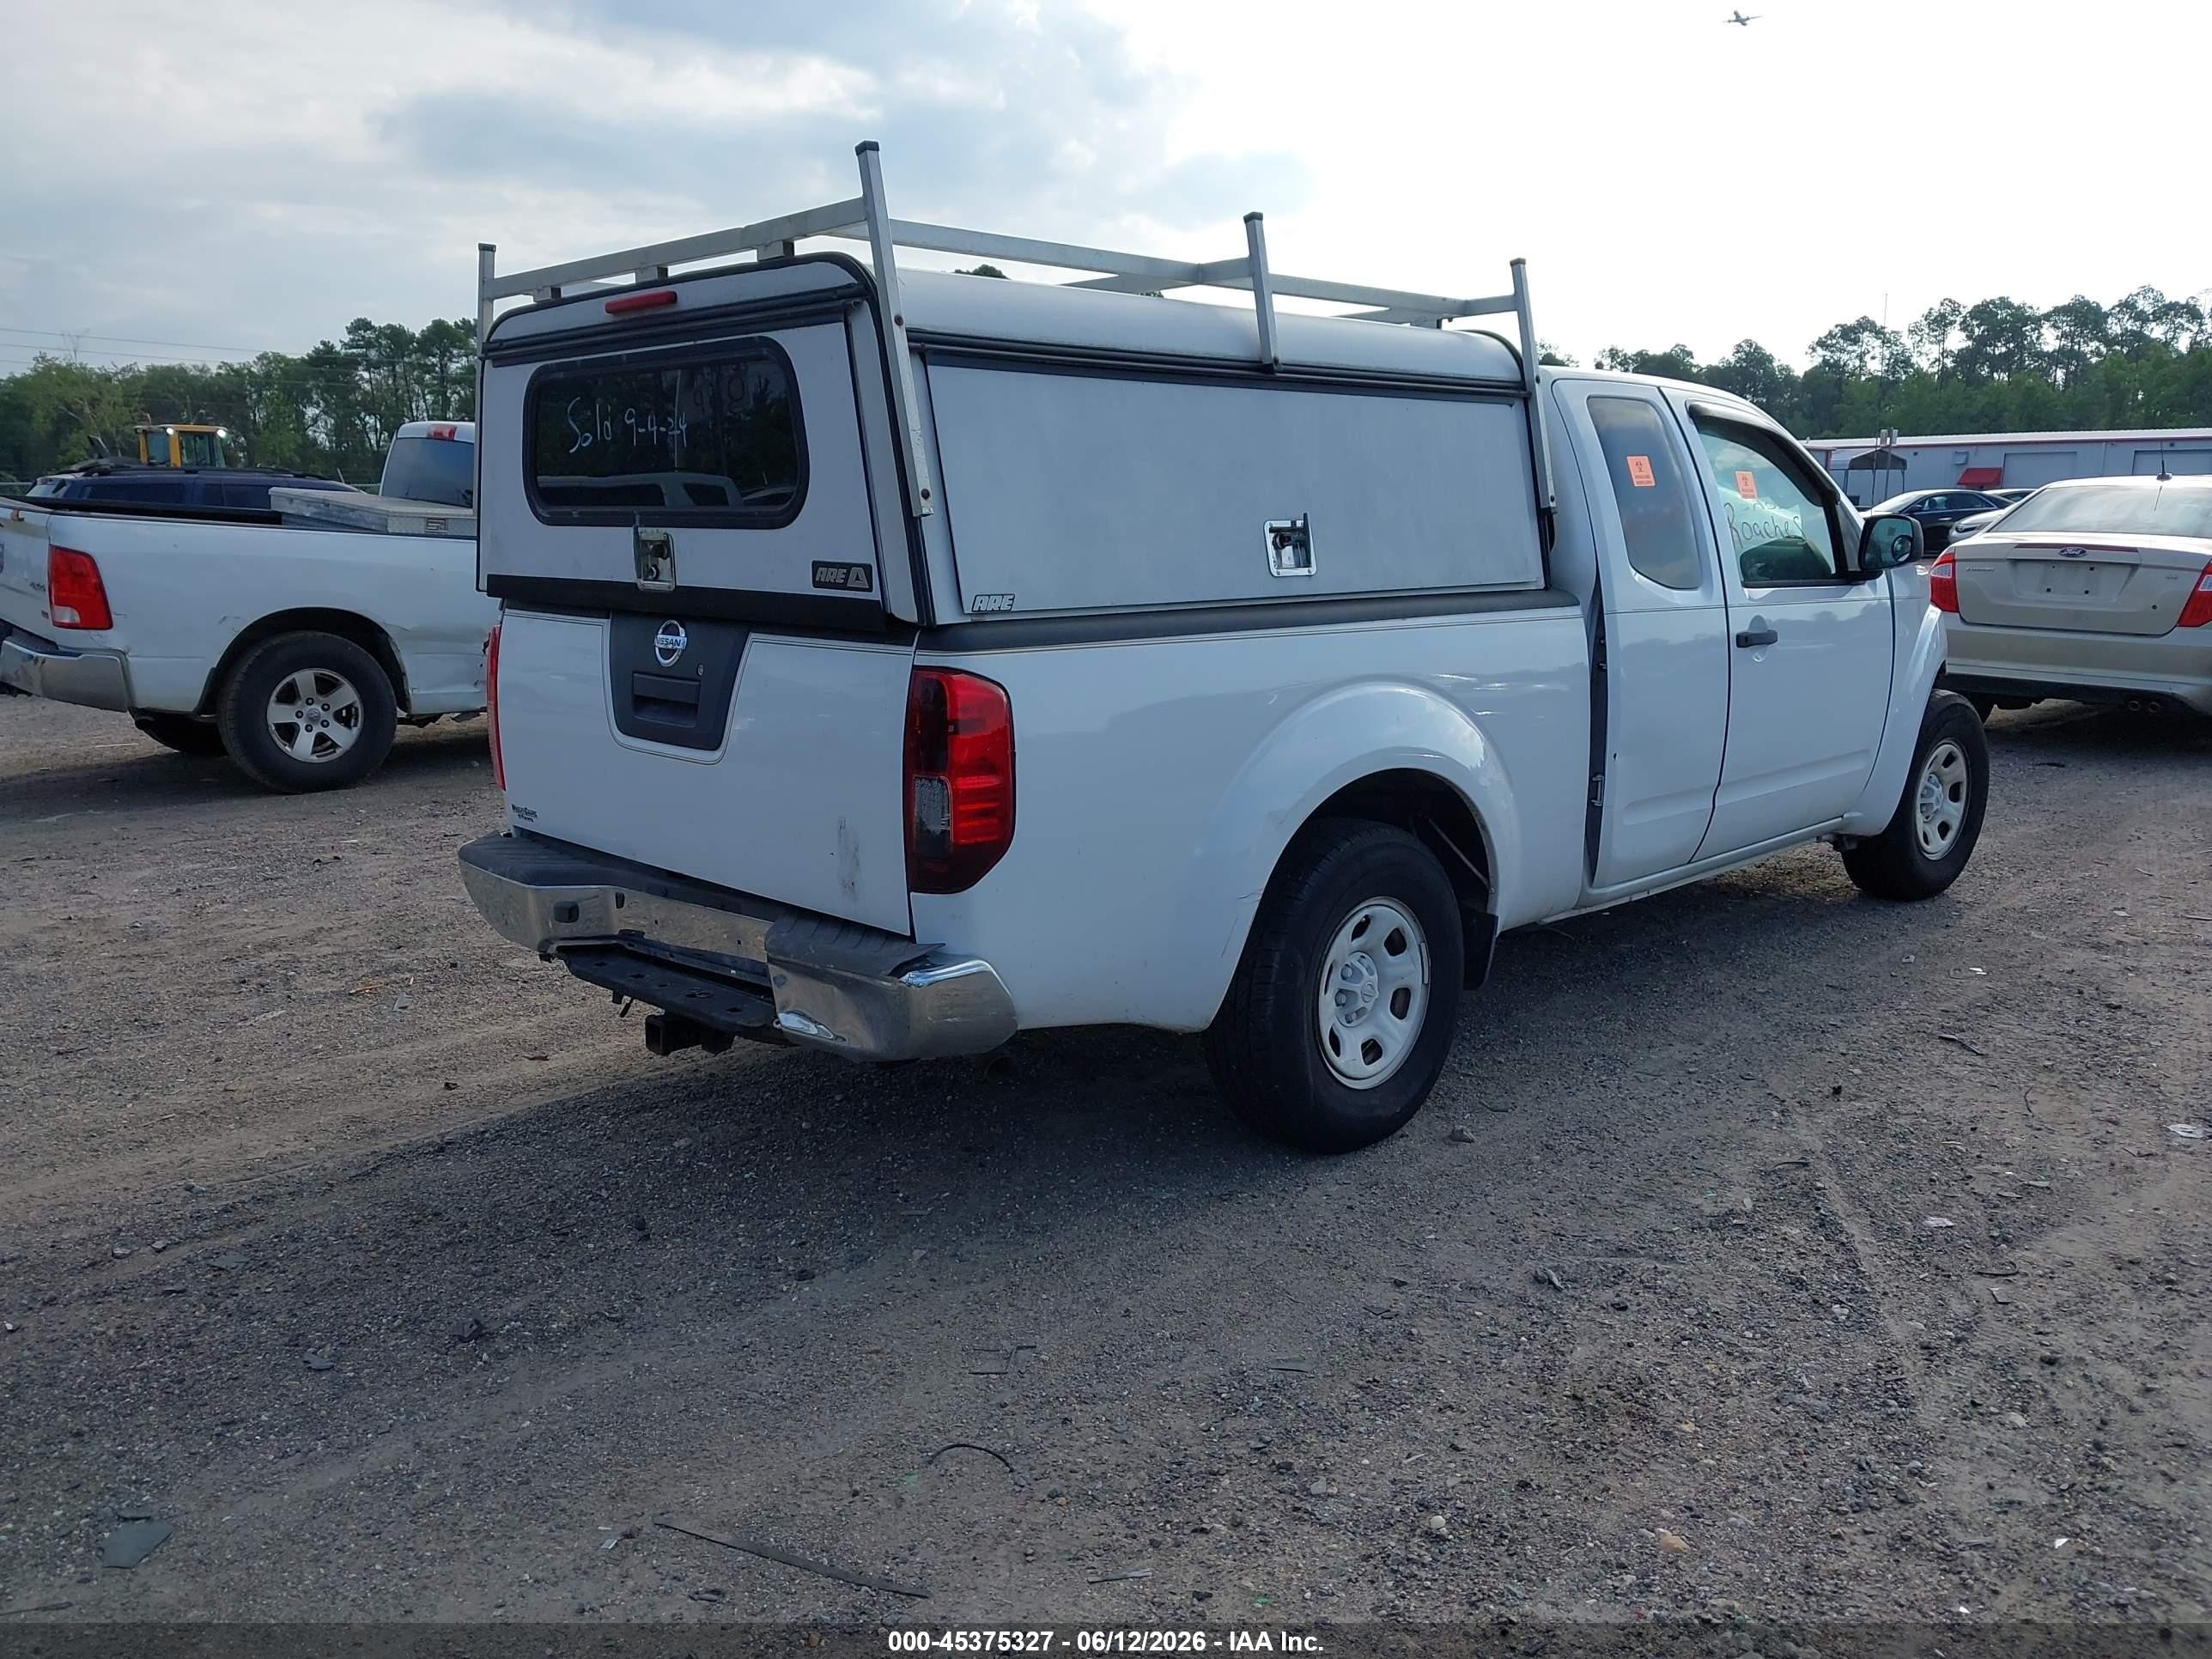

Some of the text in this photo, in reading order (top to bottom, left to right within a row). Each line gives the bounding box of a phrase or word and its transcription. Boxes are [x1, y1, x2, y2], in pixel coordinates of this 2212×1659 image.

[567, 396, 612, 454] Sold
[1723, 501, 1807, 550] Roaches
[814, 566, 848, 584] ARE
[972, 594, 1016, 612] ARE
[655, 635, 682, 647] NISSAN
